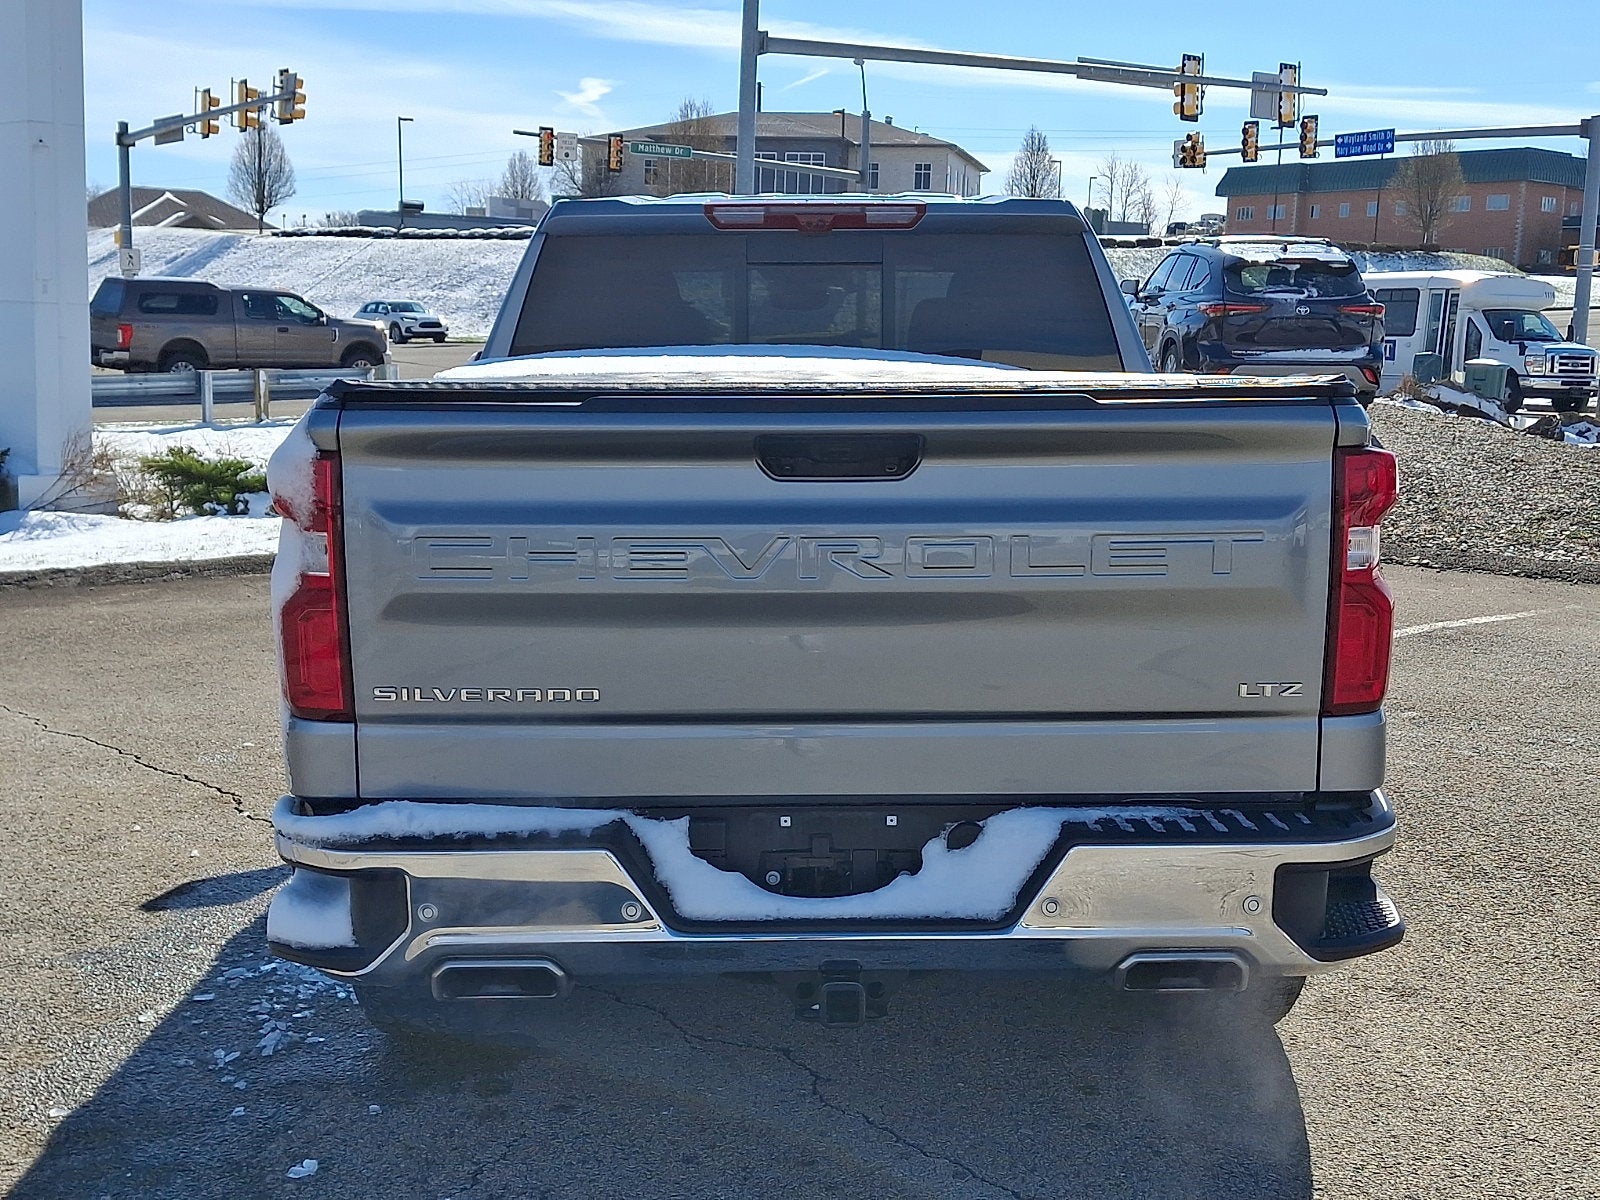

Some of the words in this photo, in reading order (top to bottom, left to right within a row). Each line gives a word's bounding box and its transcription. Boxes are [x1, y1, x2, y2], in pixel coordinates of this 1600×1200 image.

[1343, 133, 1367, 145] Wayland
[1368, 131, 1385, 142] Smith
[1386, 130, 1393, 140] Dr
[638, 143, 672, 154] Matthew
[674, 147, 684, 155] Dr
[1336, 145, 1349, 156] Mary
[1362, 143, 1377, 153] Wood
[412, 530, 1266, 581] CHEVROLET
[372, 685, 601, 703] SILVERADO
[1238, 681, 1303, 698] LTZ
